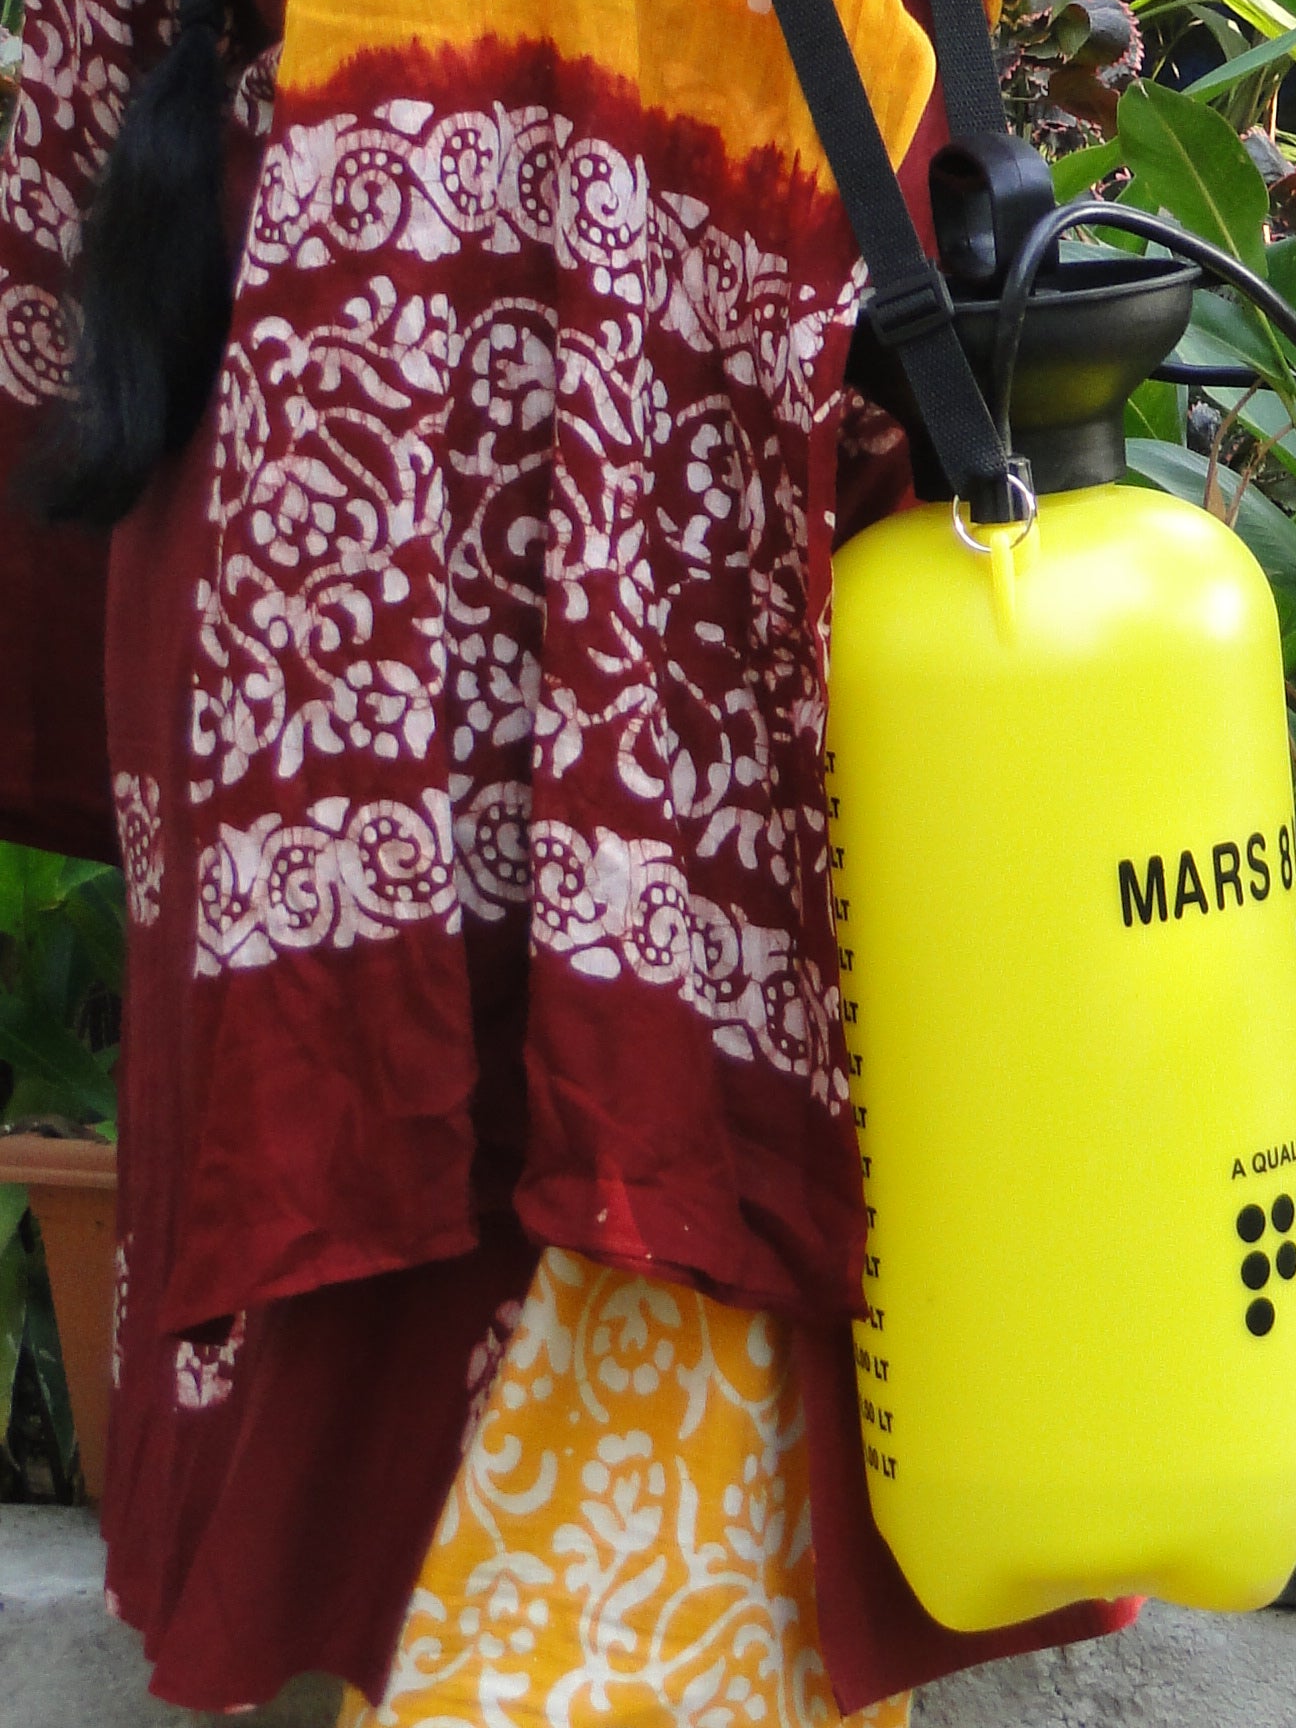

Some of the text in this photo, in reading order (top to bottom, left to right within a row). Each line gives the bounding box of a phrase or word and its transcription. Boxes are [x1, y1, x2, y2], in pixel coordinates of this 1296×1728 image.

[1118, 832, 1270, 928] MARS
[835, 898, 849, 921] LT
[839, 946, 854, 971] LT
[843, 998, 858, 1023] LT
[1232, 1158, 1246, 1180] A
[874, 1356, 889, 1381] LT
[878, 1408, 893, 1433] LT
[881, 1453, 896, 1479] LT
